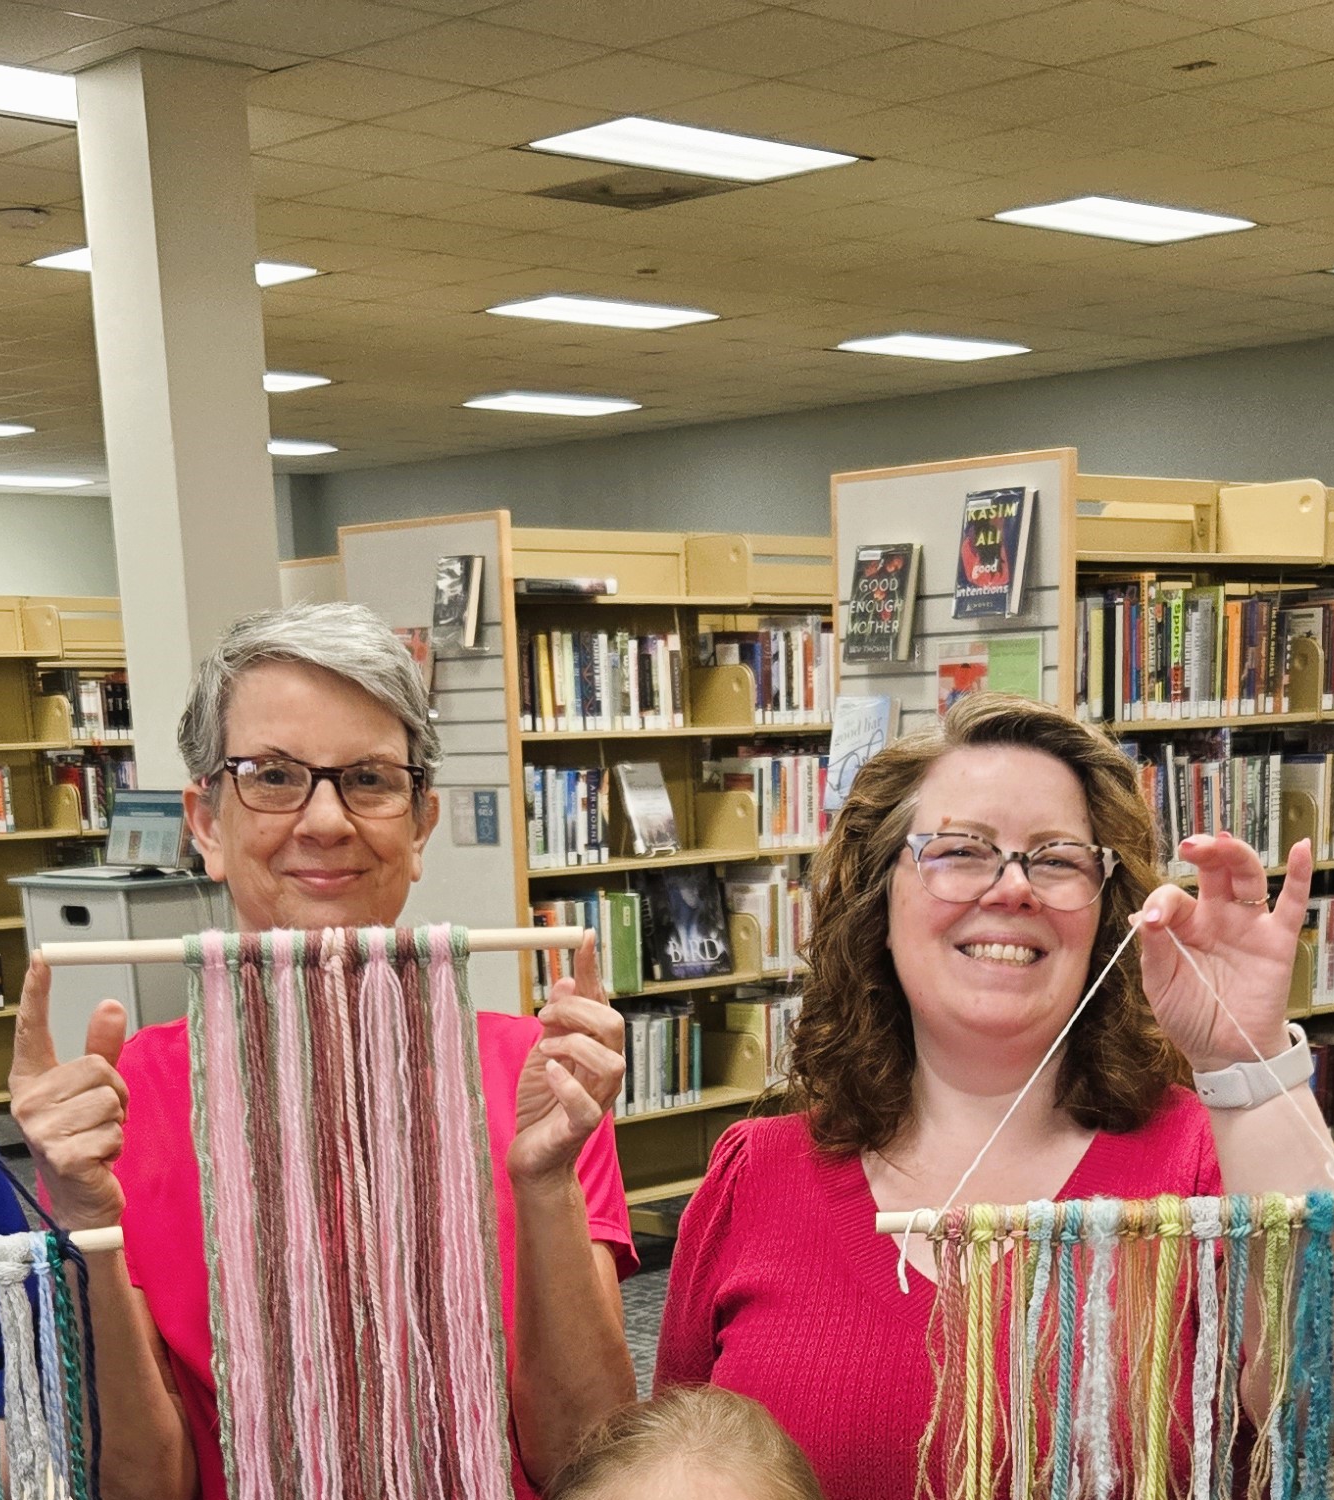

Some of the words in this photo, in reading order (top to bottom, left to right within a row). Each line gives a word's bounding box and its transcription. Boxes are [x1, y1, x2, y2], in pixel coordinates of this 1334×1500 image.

[967, 502, 1017, 521] KASIM
[975, 530, 1001, 546] ALI
[972, 558, 998, 579] good
[859, 578, 898, 592] GOOD
[956, 584, 1008, 598] intentions
[850, 599, 903, 613] ENOUGH
[848, 620, 899, 634] MOTHER
[668, 938, 721, 962] BIRD
